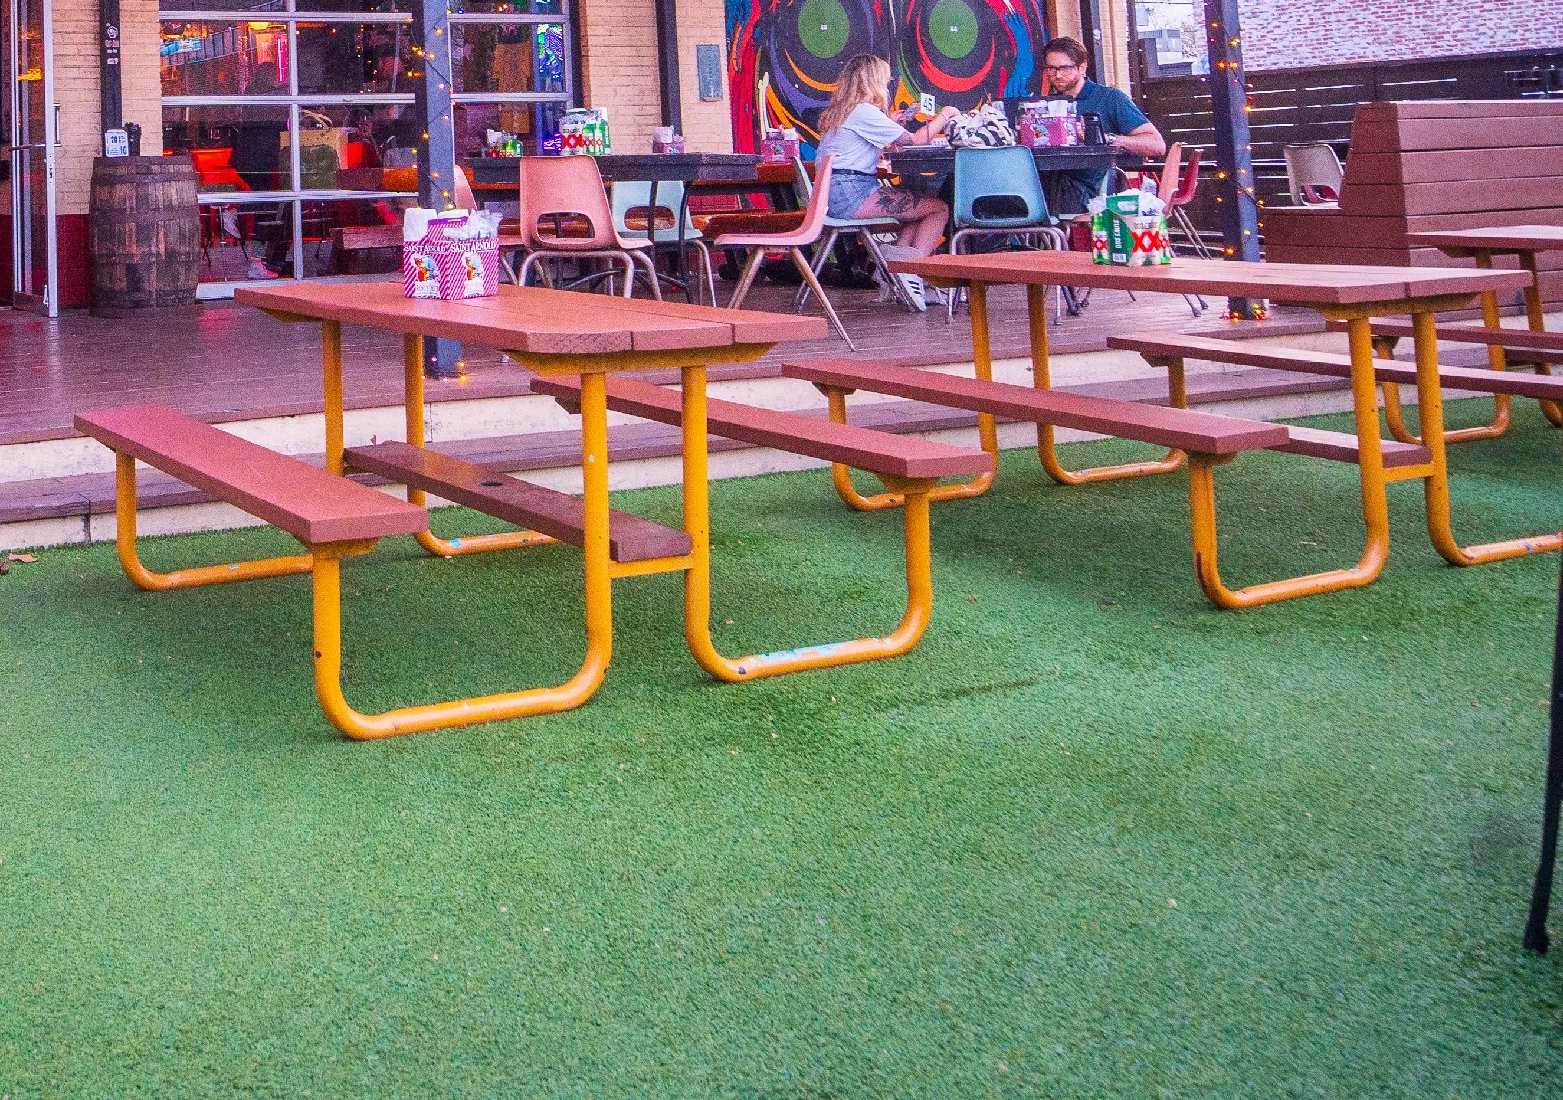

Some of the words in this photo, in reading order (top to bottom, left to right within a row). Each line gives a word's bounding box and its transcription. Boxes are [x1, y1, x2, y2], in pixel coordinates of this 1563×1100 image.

[923, 97, 933, 112] 45
[450, 243, 471, 253] SAINT
[471, 240, 497, 254] ARNOLD
